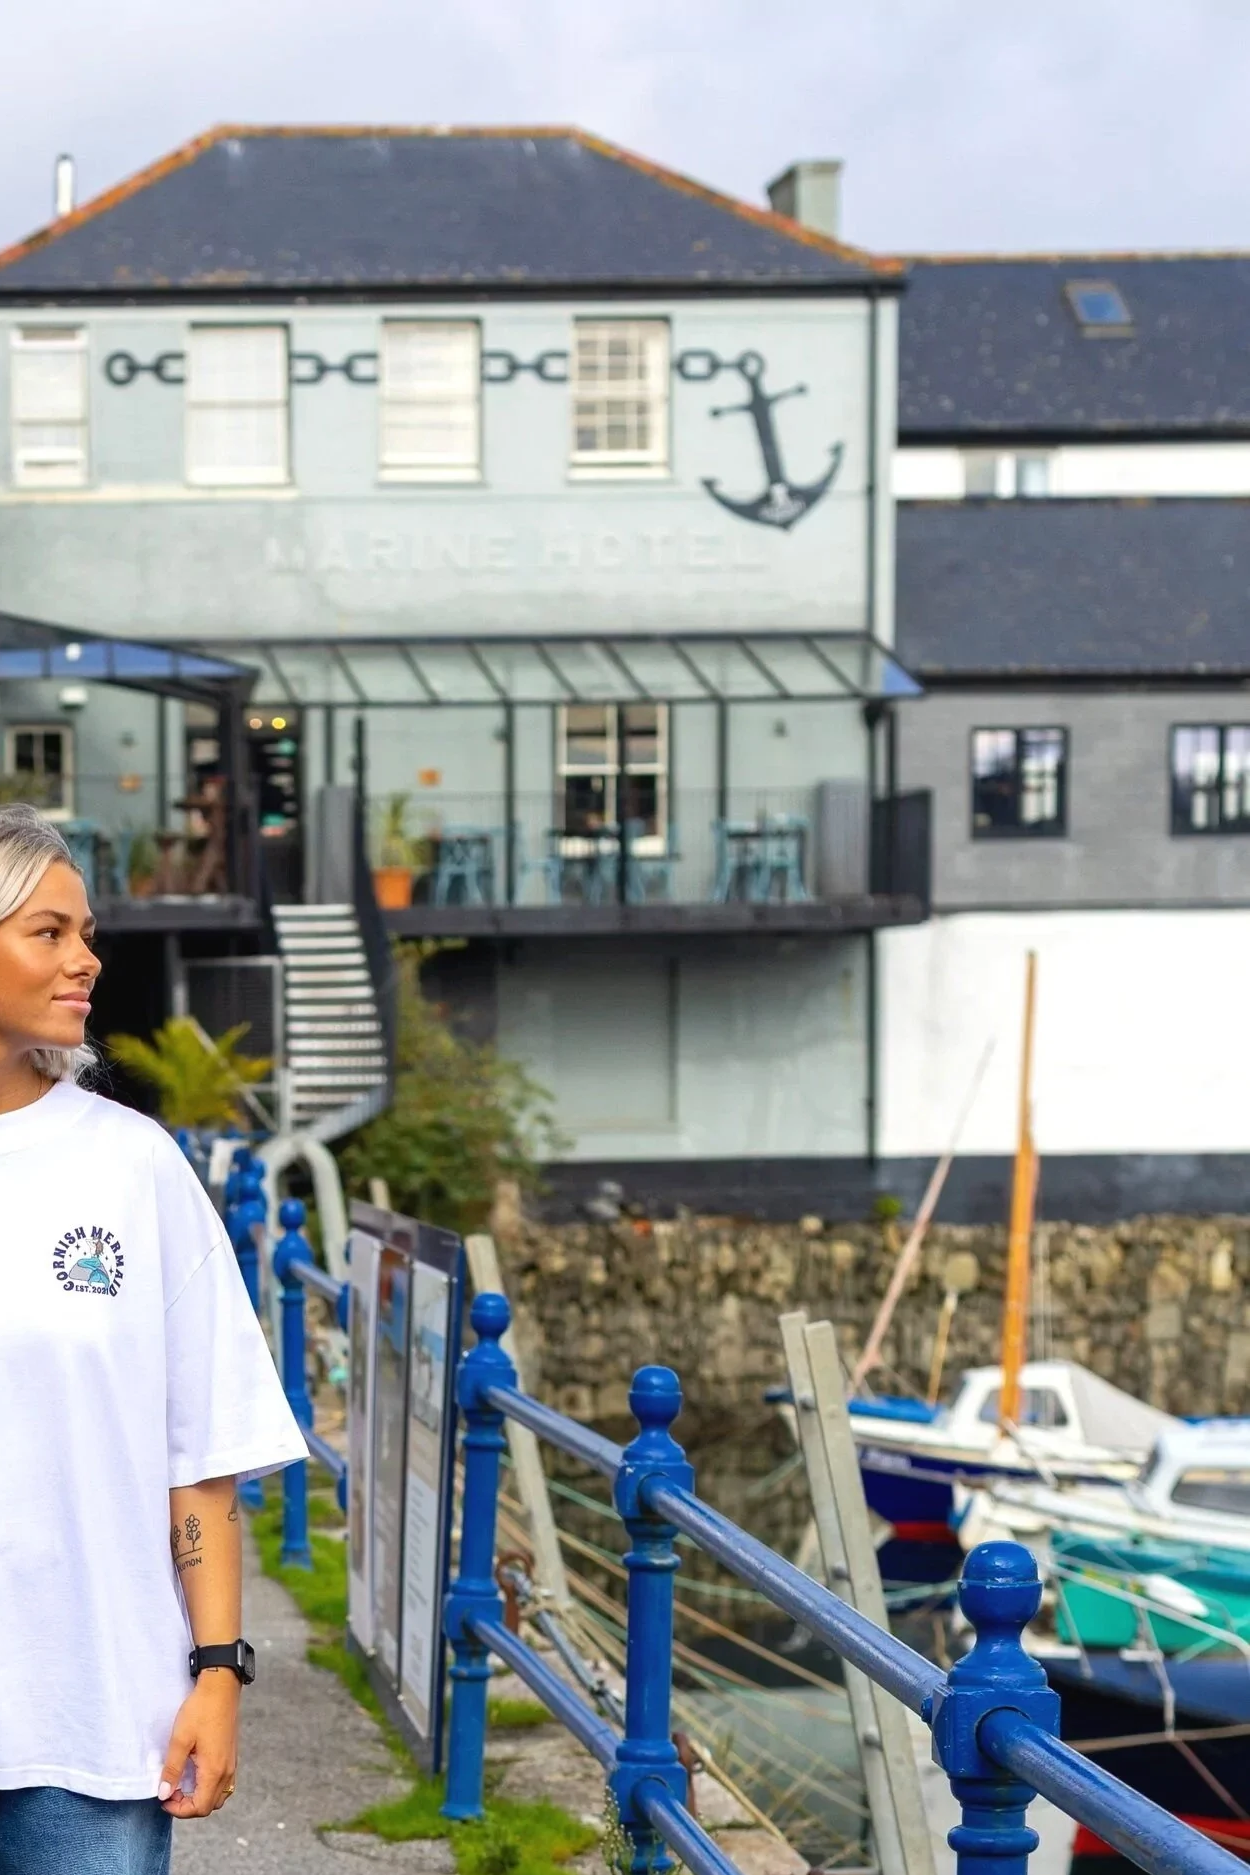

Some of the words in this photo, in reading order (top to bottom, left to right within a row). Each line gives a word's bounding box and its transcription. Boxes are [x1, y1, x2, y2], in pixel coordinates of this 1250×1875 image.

[540, 531, 768, 574] HOTEL
[53, 1226, 86, 1291] CORNISH
[90, 1226, 124, 1297] MERMAID
